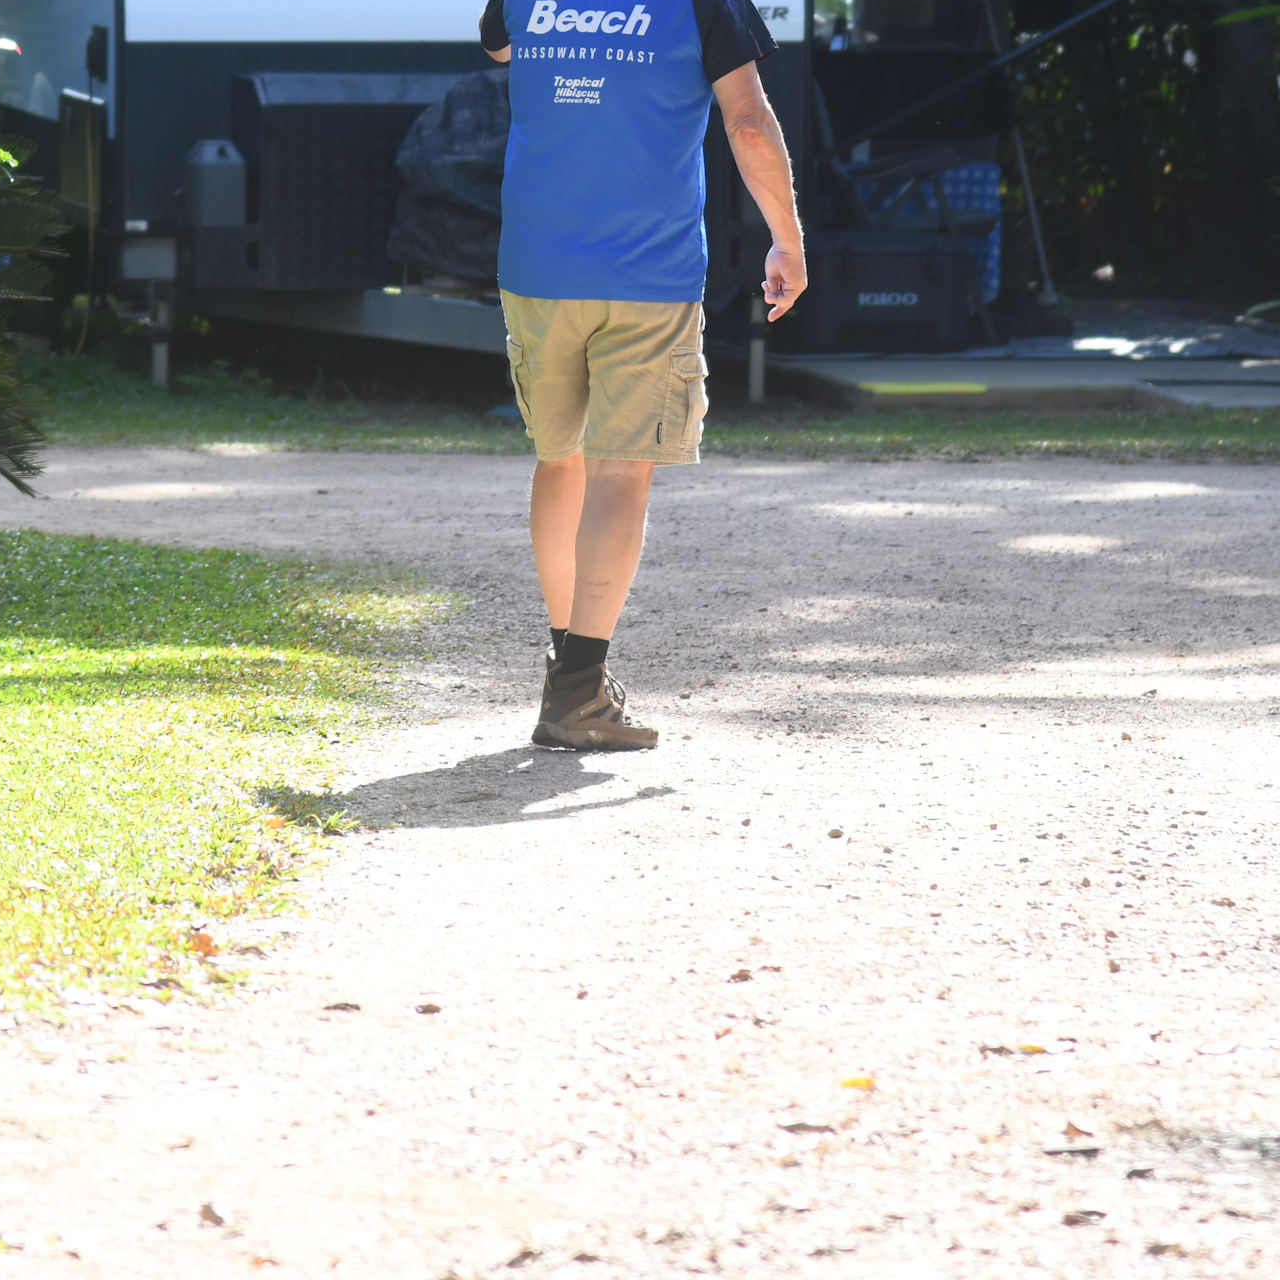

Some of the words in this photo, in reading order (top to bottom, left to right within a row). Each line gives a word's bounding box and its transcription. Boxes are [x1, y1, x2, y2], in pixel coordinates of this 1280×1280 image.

[526, 0, 651, 36] Beach
[517, 47, 597, 60] CASSOWARY
[606, 48, 655, 64] COAST
[553, 75, 606, 89] Tropical
[555, 87, 601, 98] Hibiscus
[553, 96, 583, 104] Caravan
[583, 97, 601, 105] Park
